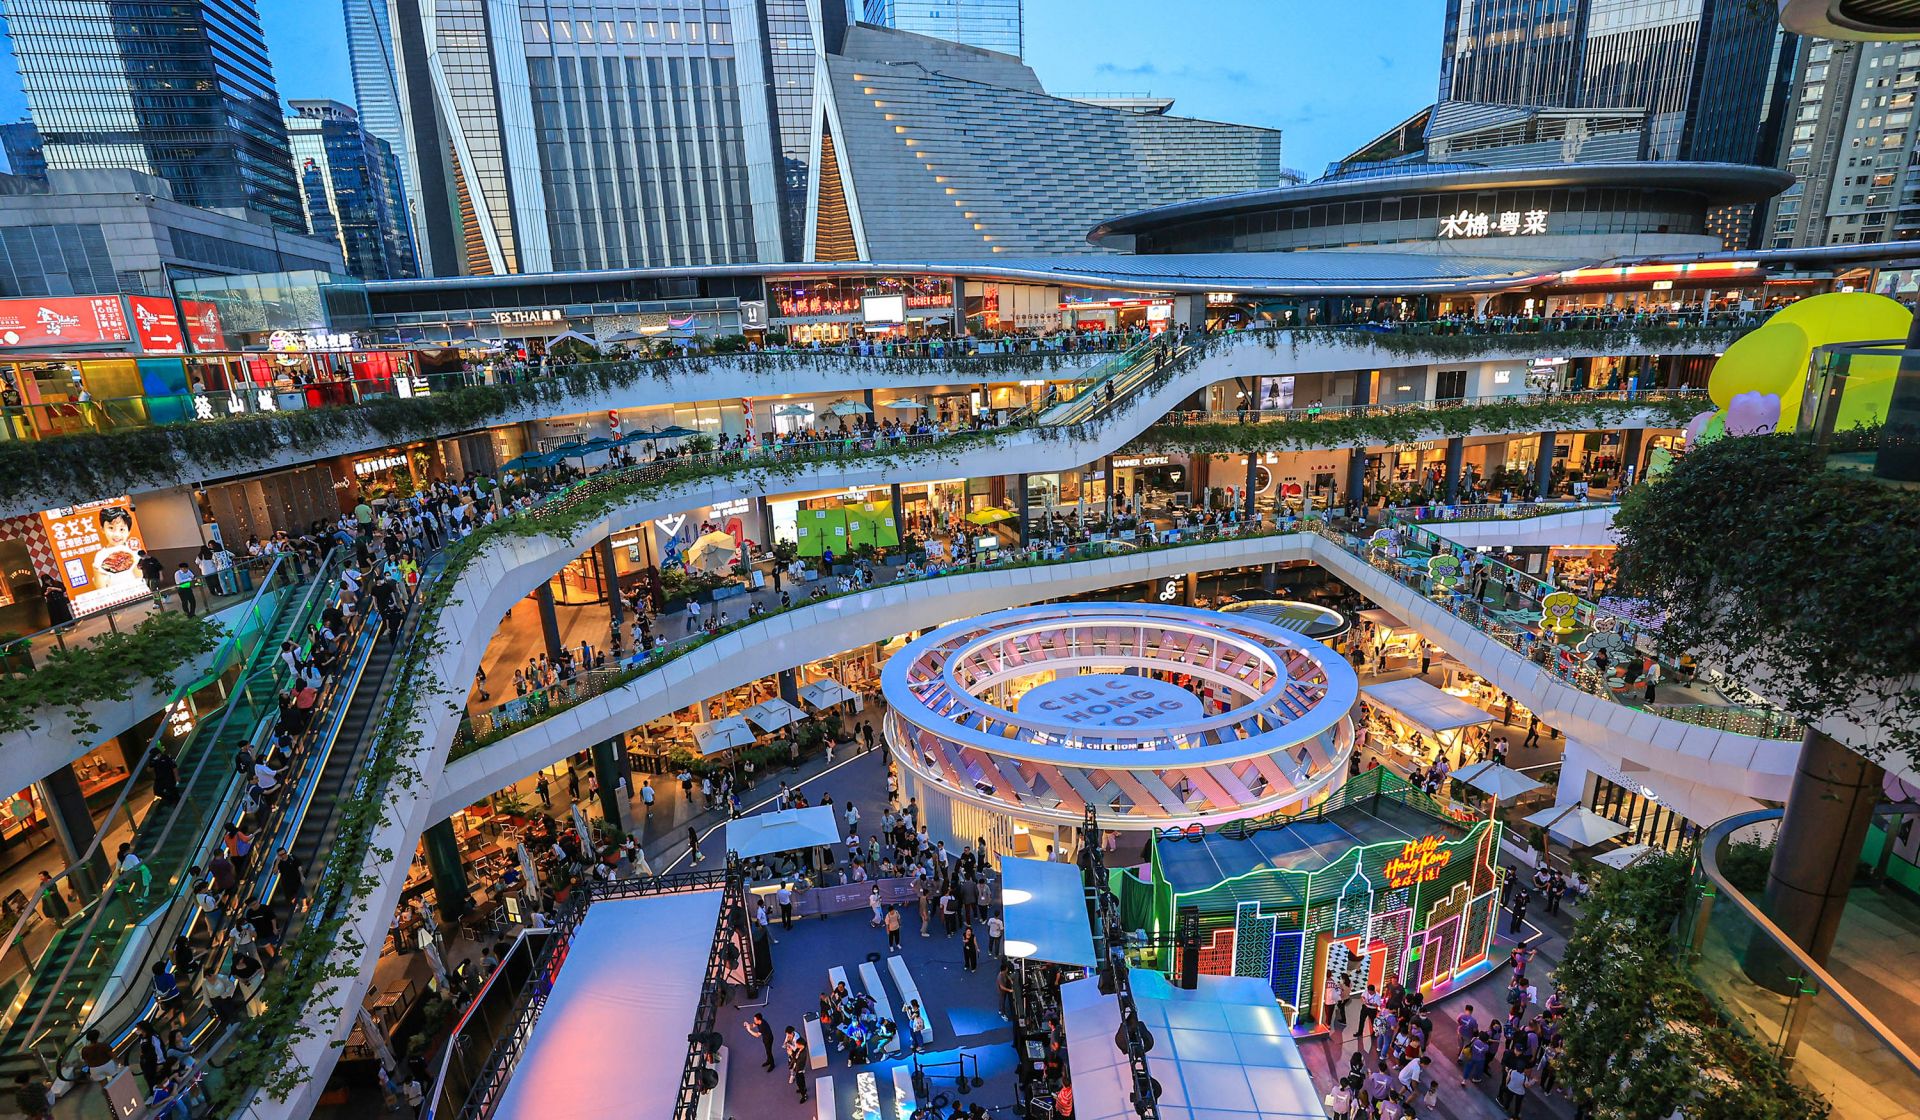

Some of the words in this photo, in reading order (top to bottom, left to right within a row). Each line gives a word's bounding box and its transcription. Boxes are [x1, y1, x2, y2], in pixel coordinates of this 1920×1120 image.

[1438, 210, 1549, 238] 木棉·粤菜
[491, 312, 512, 324] YES
[512, 310, 541, 323] THAI
[1143, 456, 1169, 466] COFFEE
[1039, 680, 1130, 712] CHIC
[1062, 689, 1156, 723] HONG
[1096, 700, 1184, 727] ONG
[1384, 857, 1420, 879] Hong
[1419, 850, 1453, 872] Kong
